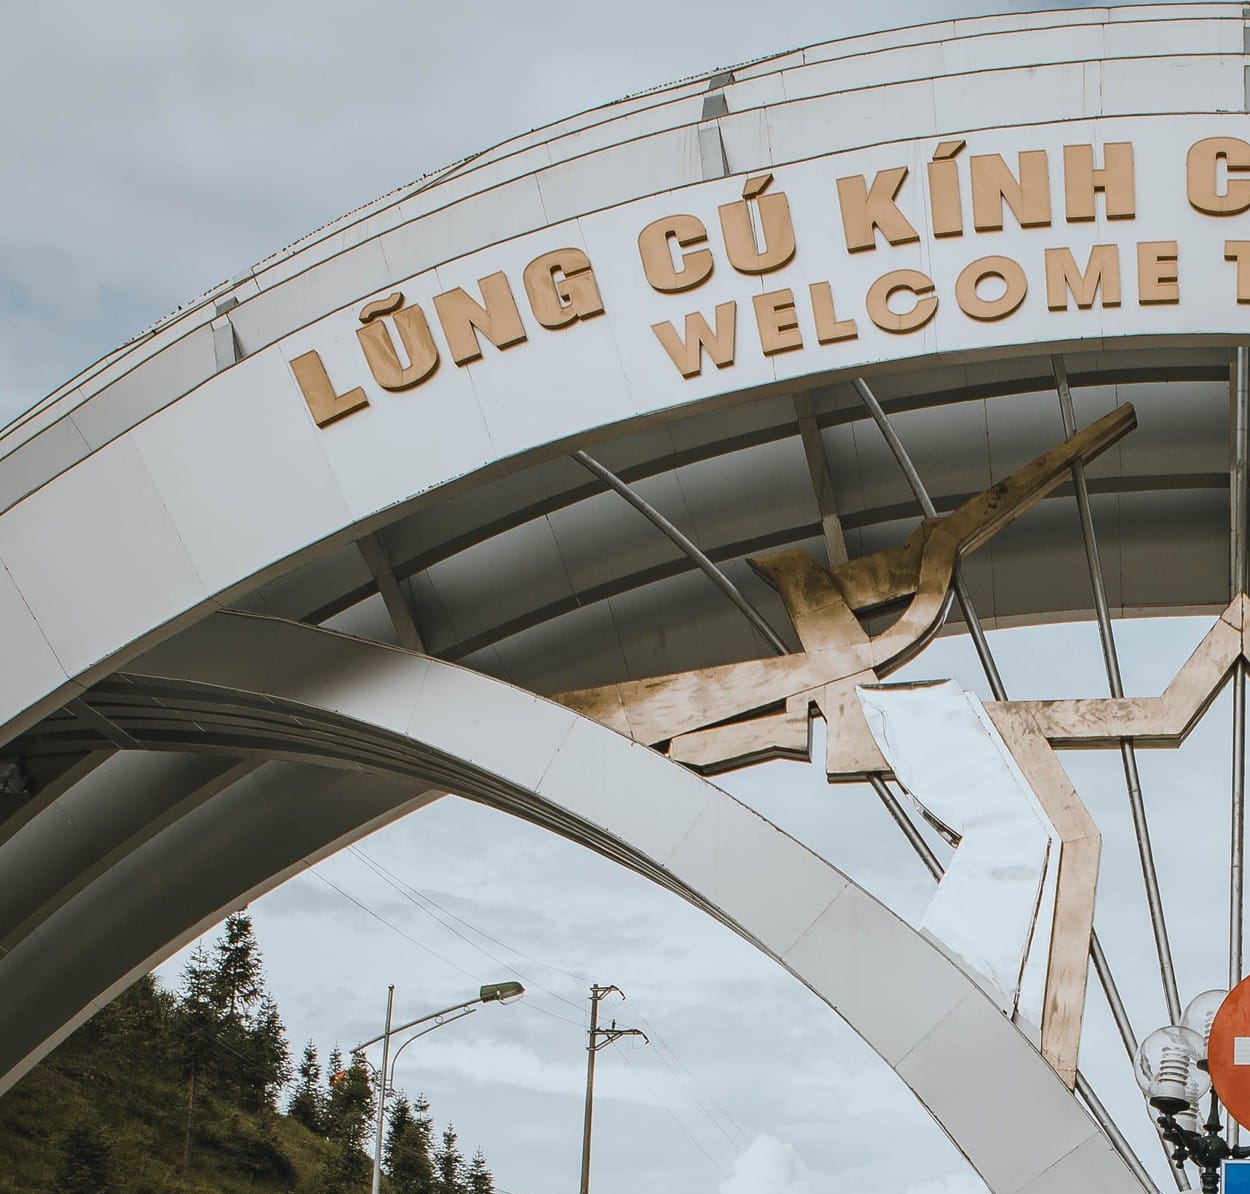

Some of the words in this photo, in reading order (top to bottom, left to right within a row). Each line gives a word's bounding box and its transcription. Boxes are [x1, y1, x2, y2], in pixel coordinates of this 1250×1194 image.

[289, 247, 606, 429] LŨNG
[637, 173, 797, 296] CÚ
[836, 139, 1137, 255] KÍNH
[650, 240, 1181, 380] WELCOME
